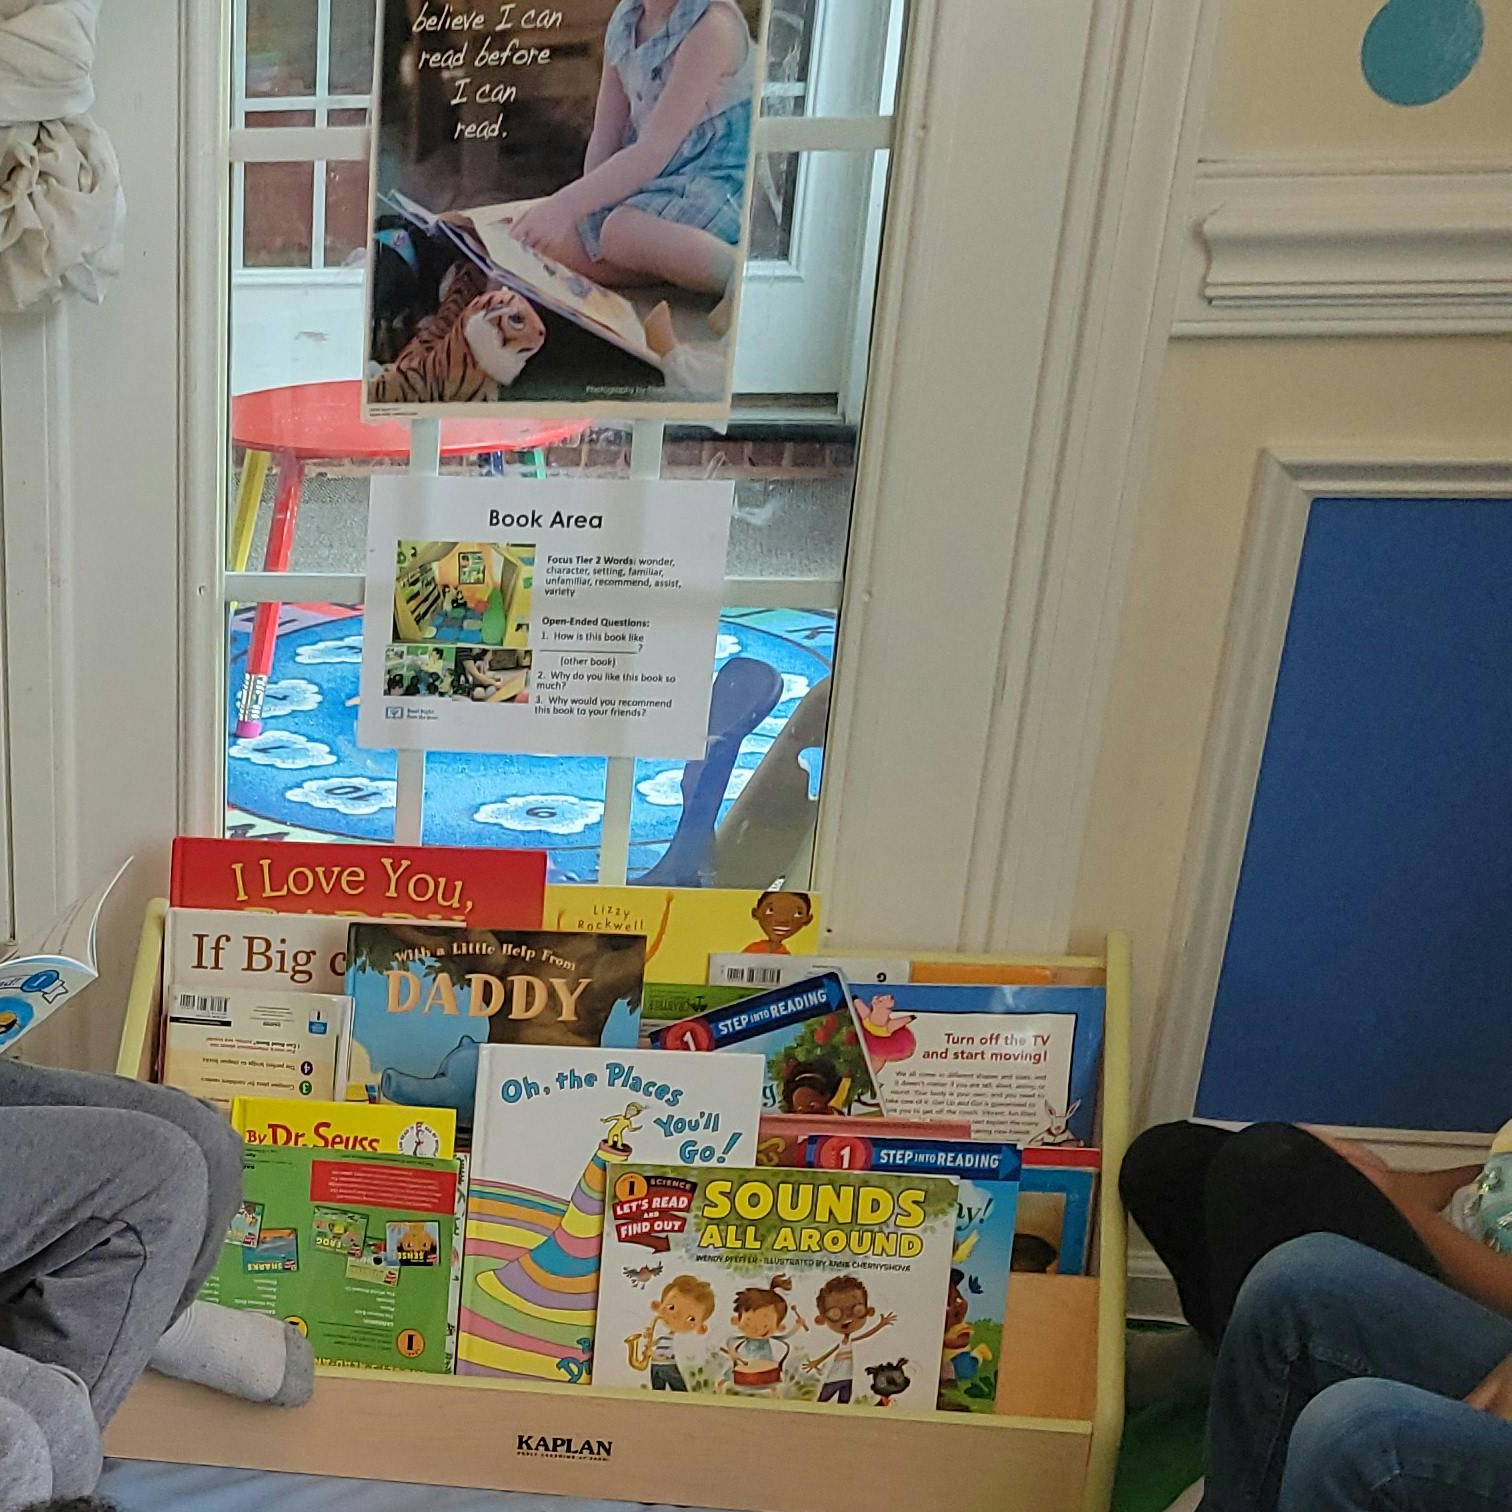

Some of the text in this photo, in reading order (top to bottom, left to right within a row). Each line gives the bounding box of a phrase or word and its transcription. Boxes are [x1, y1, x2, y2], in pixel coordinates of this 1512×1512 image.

[412, 2, 563, 33] believe I can
[418, 36, 551, 69] read before
[450, 78, 517, 106] I can
[453, 113, 508, 139] read.
[489, 509, 603, 529] Book Area
[547, 555, 676, 567] Focus Tier 2 Words: wonder,
[546, 566, 664, 578] character, setting, familiar,
[545, 576, 682, 589] unfamiliar, recommend, assist,
[544, 587, 575, 598] variety
[541, 617, 650, 628] Open-Ended Questions:
[553, 632, 574, 641] How
[576, 632, 583, 640] is
[585, 632, 602, 641] this
[604, 632, 626, 642] book
[628, 633, 644, 642] like
[560, 656, 617, 667] (other book)
[536, 681, 567, 690] much?
[550, 672, 570, 682] Why
[572, 671, 584, 680] do
[586, 673, 603, 682] you
[605, 672, 620, 681] like
[622, 672, 638, 682] this
[640, 673, 663, 682] book
[548, 696, 570, 707] Why
[574, 696, 598, 706] would
[600, 698, 616, 707] you
[618, 699, 672, 708] recommend
[534, 706, 647, 718] this book to your friends?
[231, 857, 474, 914] I Love You,
[593, 904, 630, 920] Lizzy
[577, 918, 643, 931] Rockwell
[191, 933, 231, 970] If
[240, 935, 316, 985] Big
[394, 942, 576, 971] With a Little Help From
[383, 969, 593, 1022] DADDY
[718, 989, 827, 1036] STEP INTO READING
[944, 1033, 1051, 1046] Turn off the TV
[922, 1047, 1048, 1064] and start moving!
[501, 1062, 683, 1107] Oh, the Places
[653, 1111, 720, 1137] You'll
[312, 1122, 380, 1152] Seuss
[679, 1132, 743, 1164] Go!
[880, 1149, 999, 1169] STEP INTO READING
[650, 1178, 692, 1190] SCIENCE
[616, 1196, 688, 1215] LET'S READ
[702, 1180, 928, 1229] SOUNDS
[620, 1221, 682, 1239] FIND OUT
[698, 1224, 923, 1258] ALL AROUND
[763, 1257, 814, 1266] ILLUSTRATED
[815, 1259, 826, 1268] BY
[516, 1434, 613, 1456] KAPLAN
